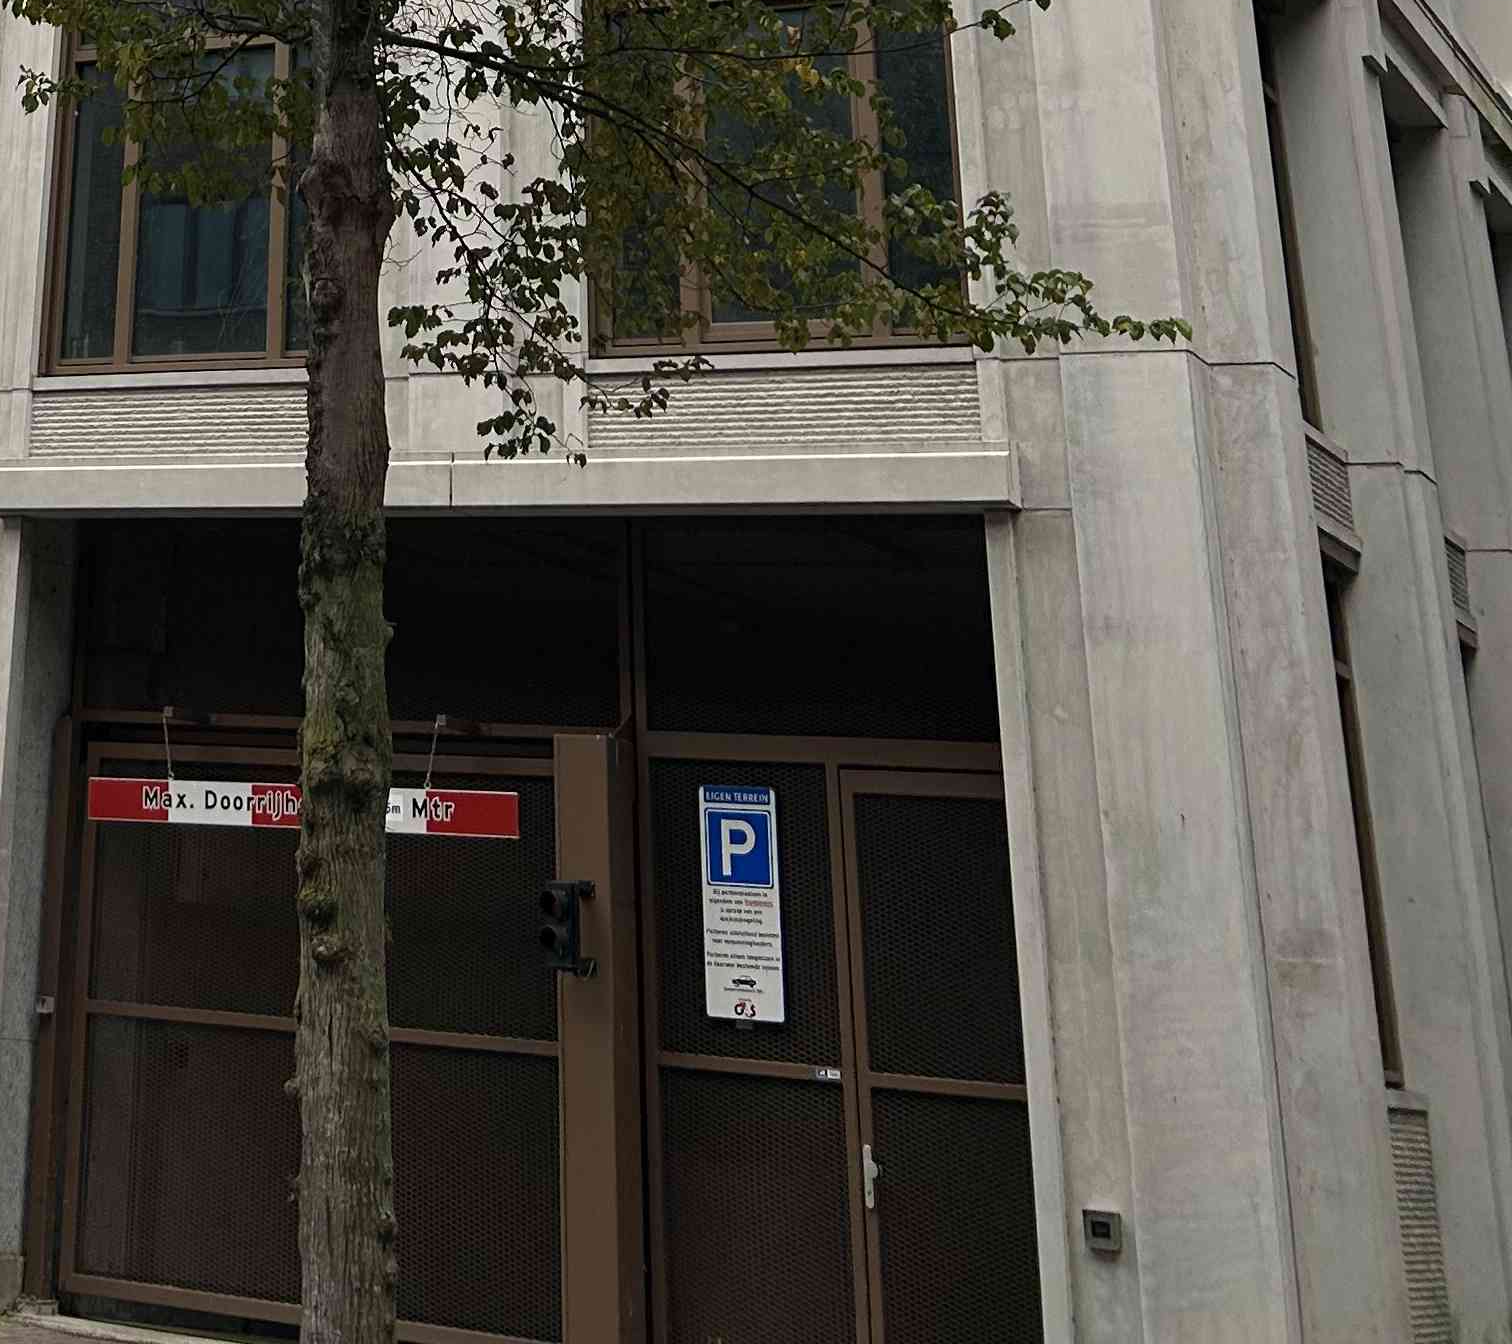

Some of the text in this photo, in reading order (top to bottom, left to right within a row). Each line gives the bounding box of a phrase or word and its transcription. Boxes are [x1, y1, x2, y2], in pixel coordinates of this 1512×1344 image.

[143, 786, 194, 810] Max.
[205, 790, 302, 821] Doorrijh
[412, 796, 455, 822] Mtr
[705, 791, 769, 803] EIGEN TERREIN
[721, 819, 756, 876] P
